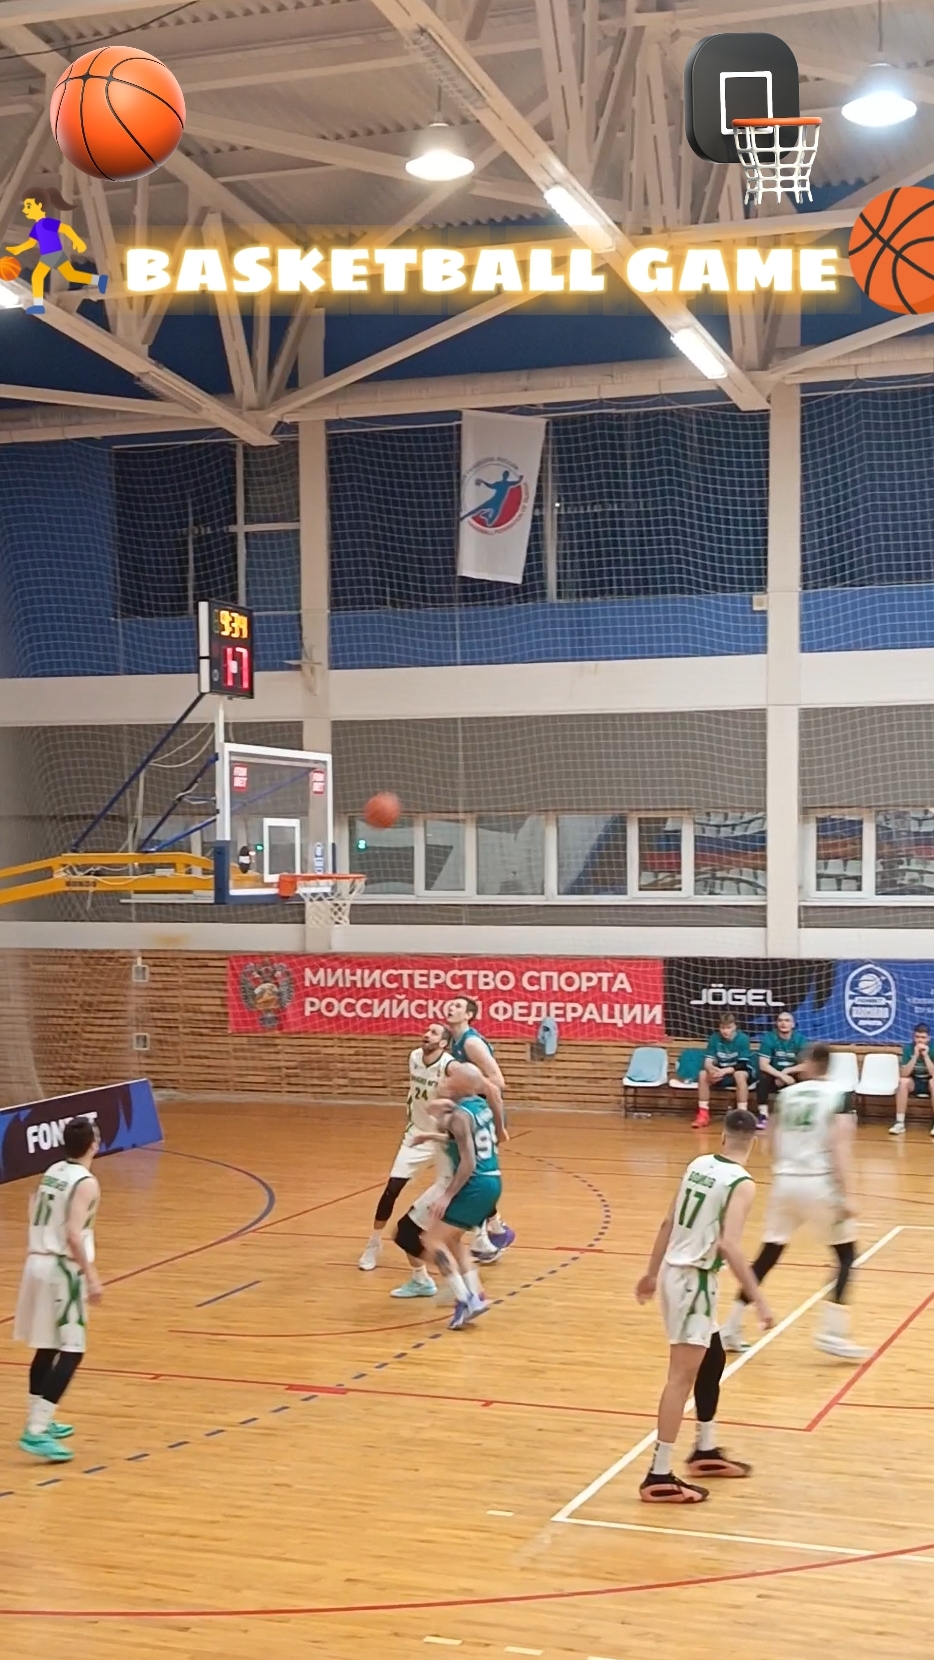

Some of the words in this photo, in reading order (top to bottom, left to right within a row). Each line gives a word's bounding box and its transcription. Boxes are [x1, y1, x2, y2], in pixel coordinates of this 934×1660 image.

[304, 967, 516, 991] МИНИСТЕРСТВО
[521, 970, 633, 993] СПОРТА
[689, 983, 786, 1007] JÖGEL
[488, 1000, 663, 1028] ФЕДЕРАЦИИ
[414, 1086, 429, 1101] 24
[678, 1187, 706, 1229] 17
